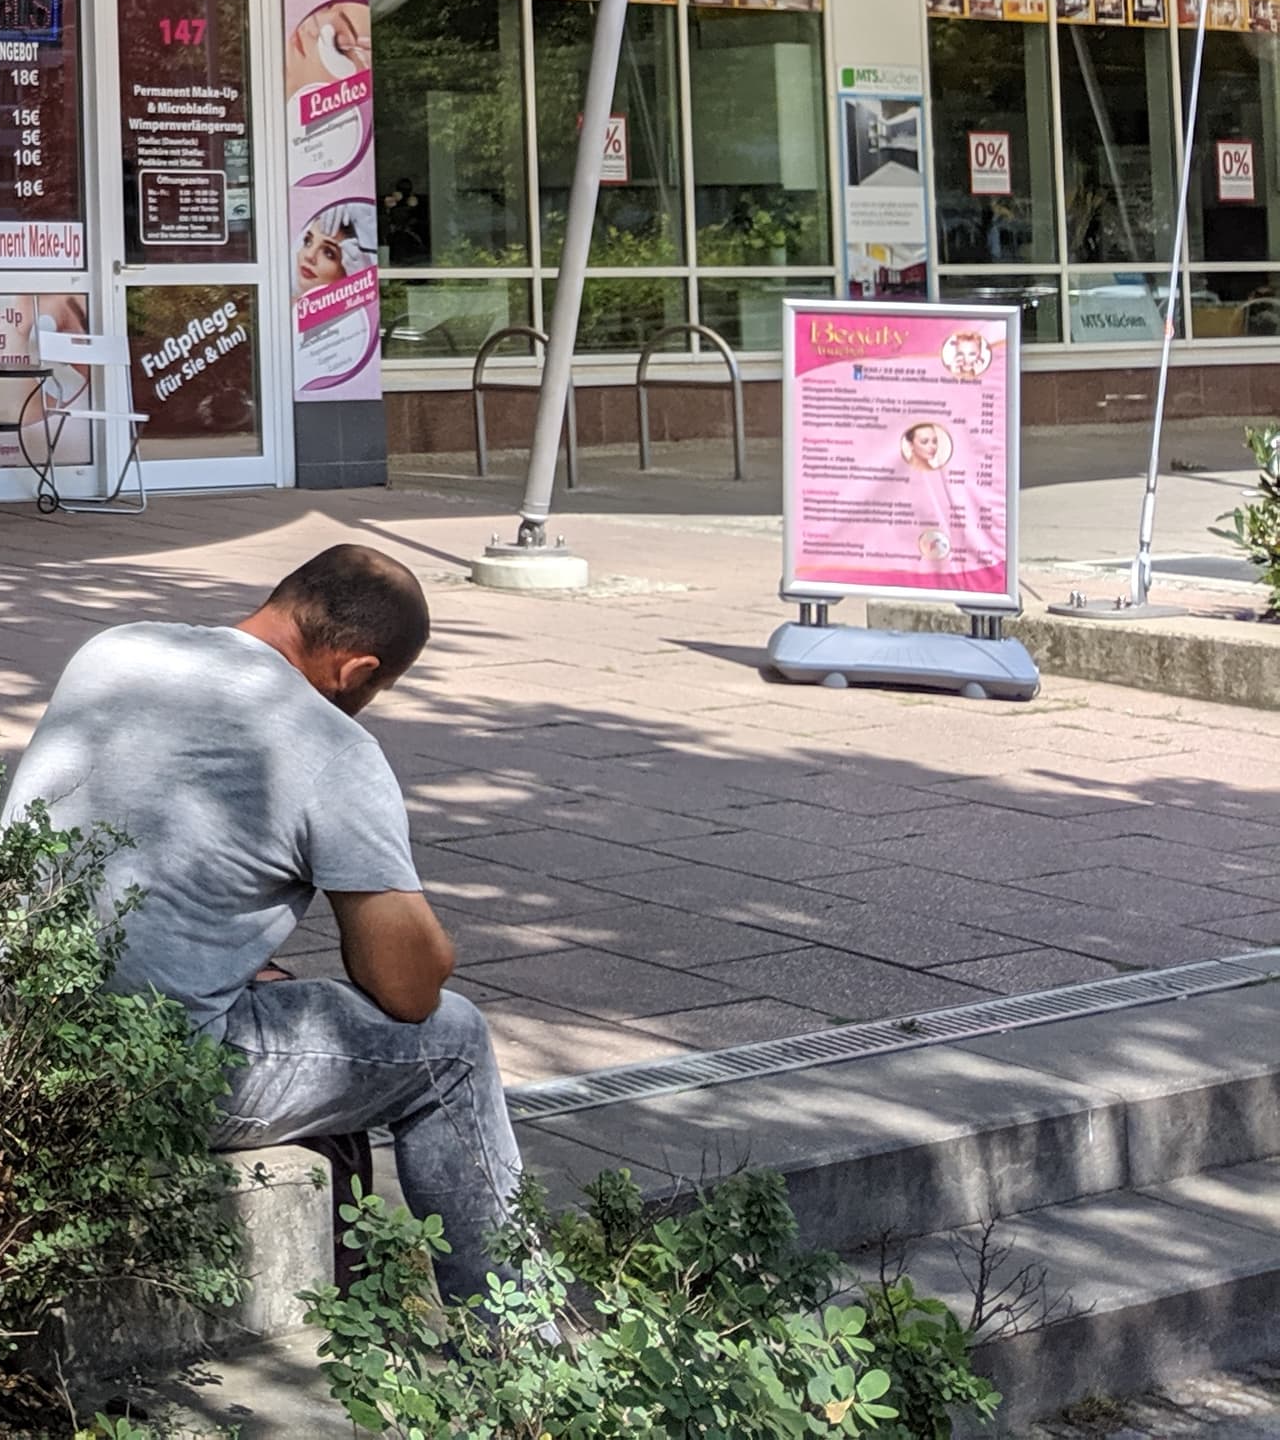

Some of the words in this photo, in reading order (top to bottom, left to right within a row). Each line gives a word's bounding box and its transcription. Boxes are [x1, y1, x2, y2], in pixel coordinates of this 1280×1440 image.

[160, 18, 207, 46] 147
[10, 69, 40, 86] 18€
[133, 84, 191, 98] Permanent
[192, 85, 238, 101] Make-Up
[310, 81, 367, 118] Lashes
[12, 109, 40, 126] 15€
[157, 102, 226, 118] Microblading
[128, 118, 245, 135] Wimpernverlängerung
[22, 129, 41, 146] 5€
[13, 149, 42, 166] 10€
[974, 141, 1006, 168] 0%
[1222, 150, 1250, 175] 0%
[14, 180, 44, 197] 18€
[28, 224, 80, 266] Make-Up
[297, 270, 374, 319] Permanent
[140, 301, 238, 378] Fußpflege
[155, 373, 183, 401] (für
[182, 357, 206, 380] Sie
[205, 346, 220, 363] &
[216, 324, 247, 355] Ihn)
